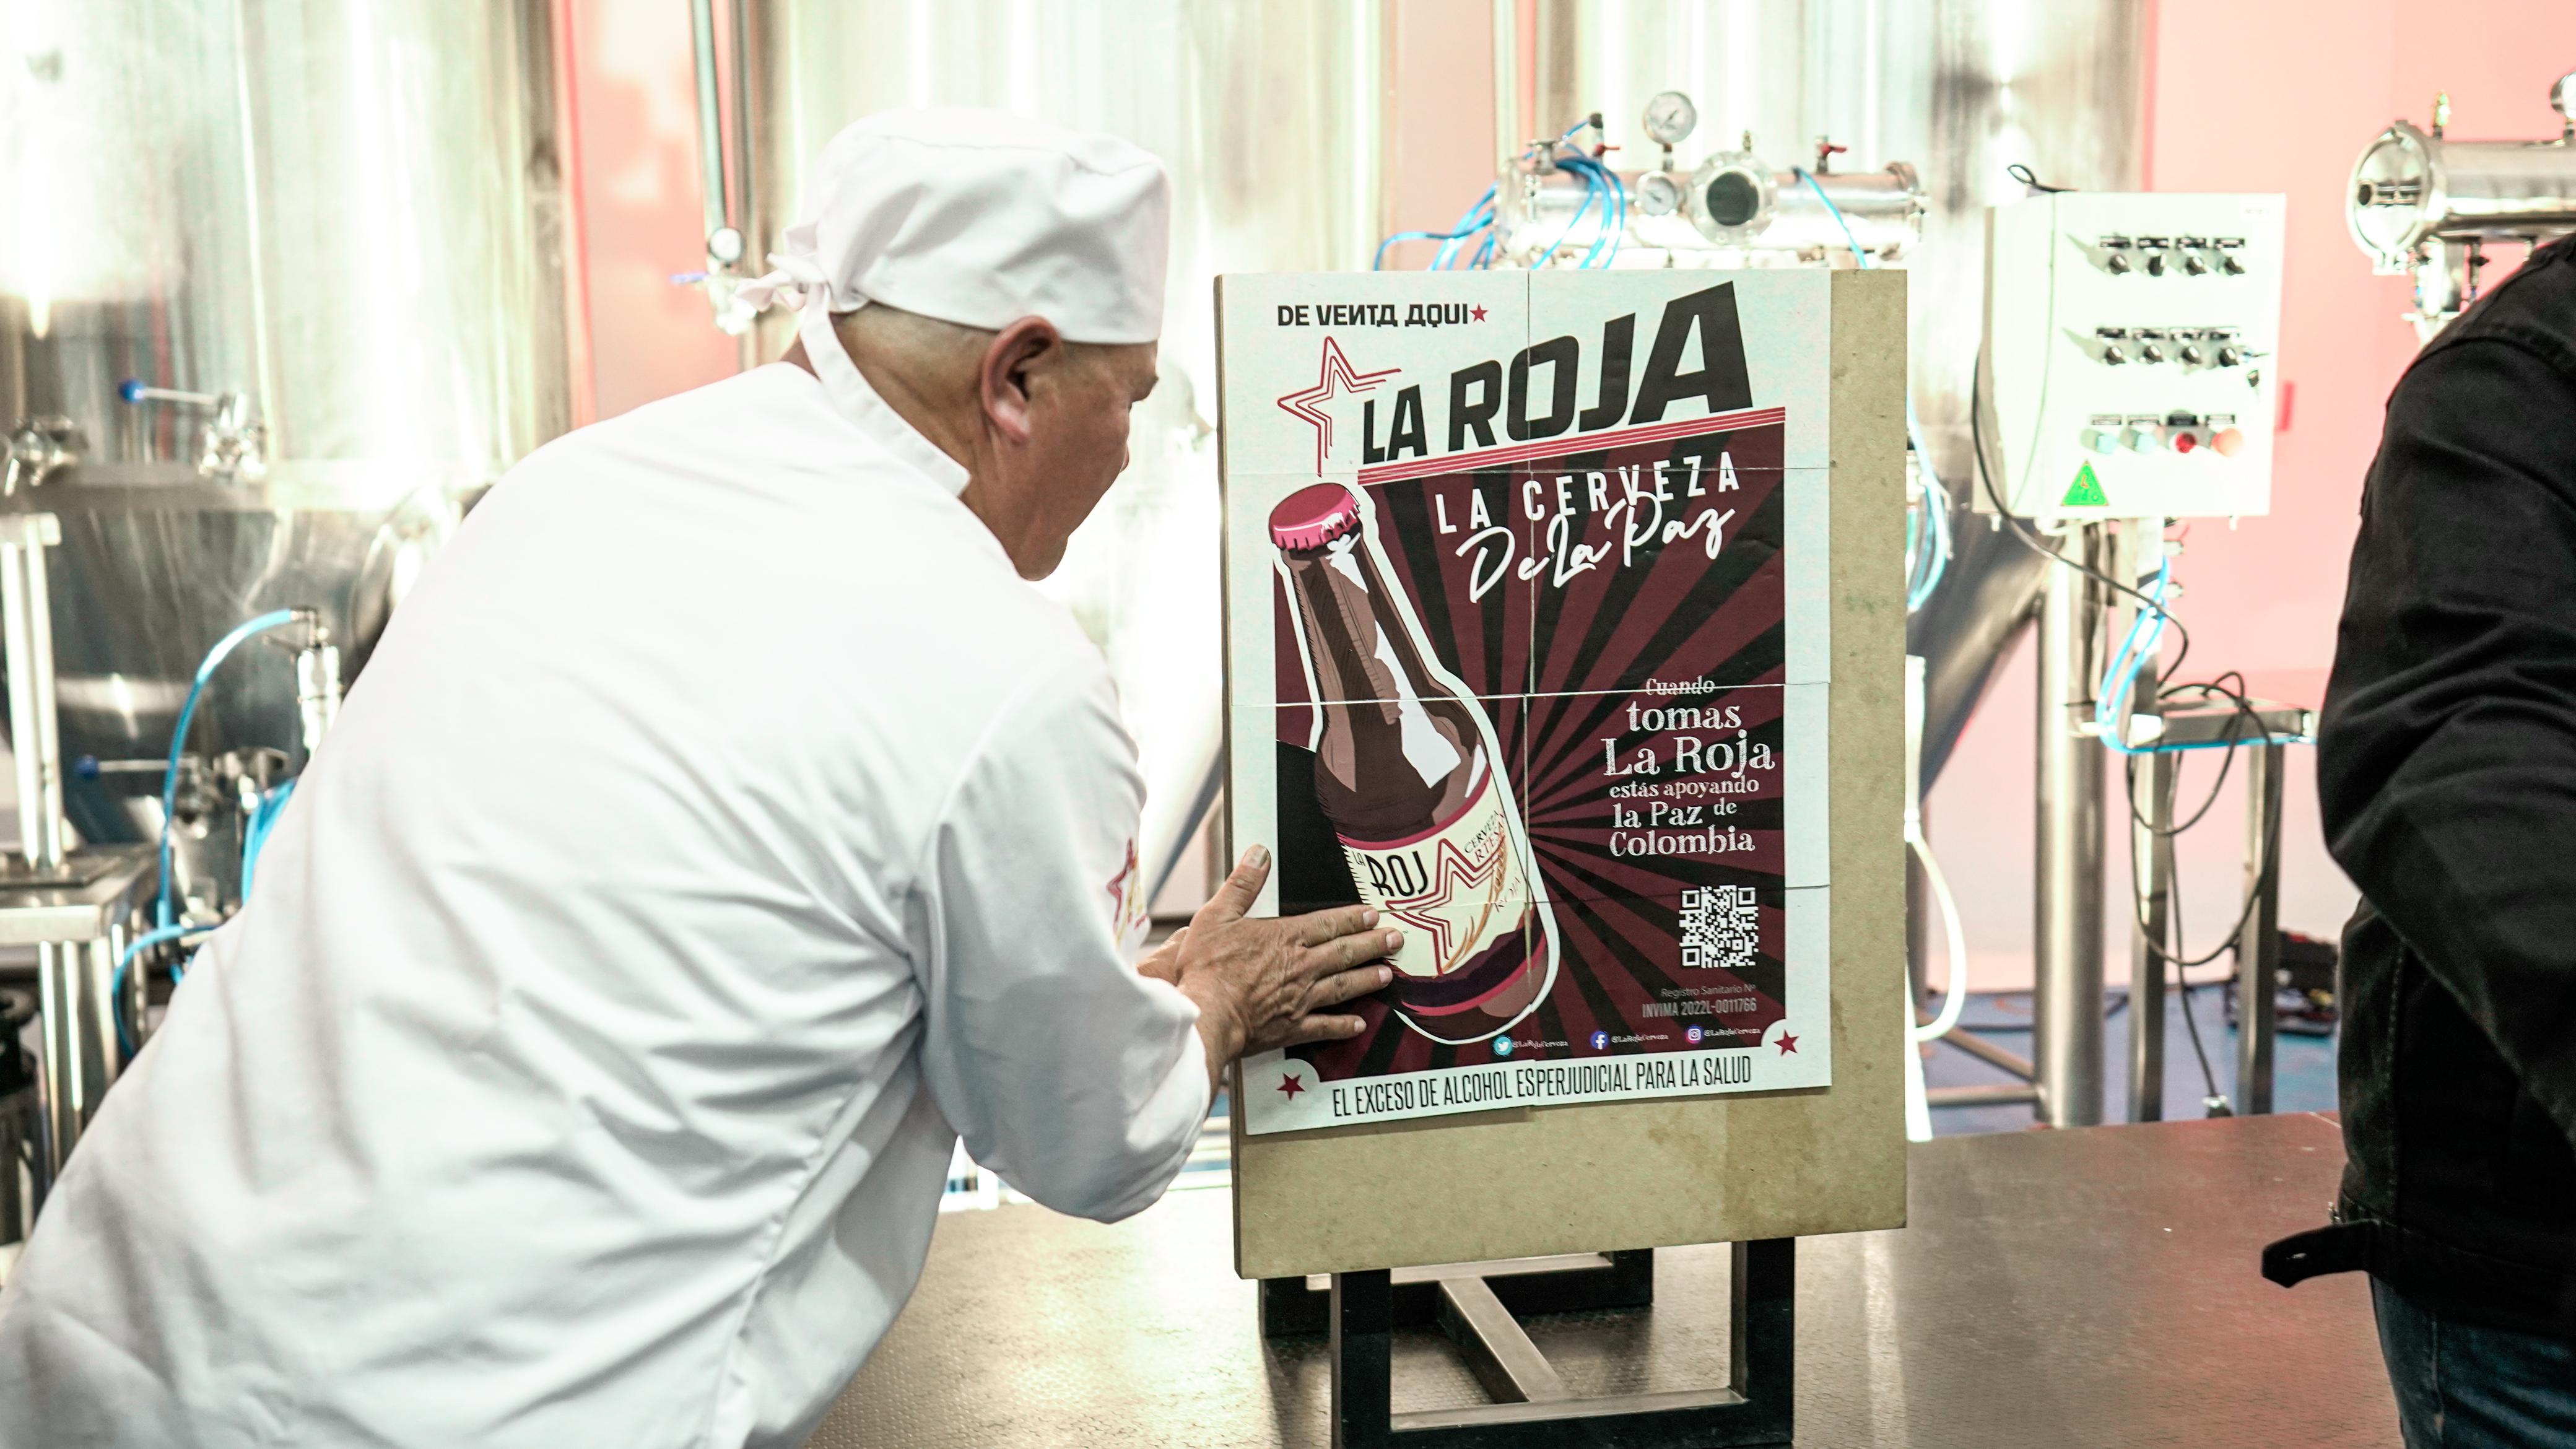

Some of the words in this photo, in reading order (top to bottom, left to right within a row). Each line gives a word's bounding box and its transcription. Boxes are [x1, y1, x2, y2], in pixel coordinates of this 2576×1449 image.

[1277, 305, 1310, 326] DE
[1363, 384, 1428, 464] LA
[1448, 281, 1753, 451] ROJA
[1435, 488, 1492, 534] LA
[1522, 451, 1740, 521] CERVEZA
[1645, 675, 1715, 695] Cuando
[1626, 700, 1742, 732] tomas
[1600, 738, 1660, 776] La
[1673, 729, 1775, 778] Roja
[1609, 779, 1659, 798] estás
[1663, 774, 1760, 799] apoyando
[1612, 803, 1642, 829] la
[1649, 801, 1704, 827] Paz
[1713, 796, 1738, 816] de
[1609, 824, 1756, 857] Colombia
[1642, 1001, 1679, 1018] INVIMA
[1681, 997, 1757, 1016] 2022L-0011766
[1661, 986, 1700, 999] Registro
[1701, 984, 1742, 995] Sanitario
[1333, 1089, 1352, 1117] EL
[1355, 1081, 1414, 1115] EXCESO
[1419, 1078, 1439, 1107] DE
[1444, 1071, 1513, 1105] ALCOHOL
[1636, 1060, 1676, 1090] PARA
[1681, 1058, 1700, 1087] LA
[1704, 1055, 1752, 1086] SALUD
